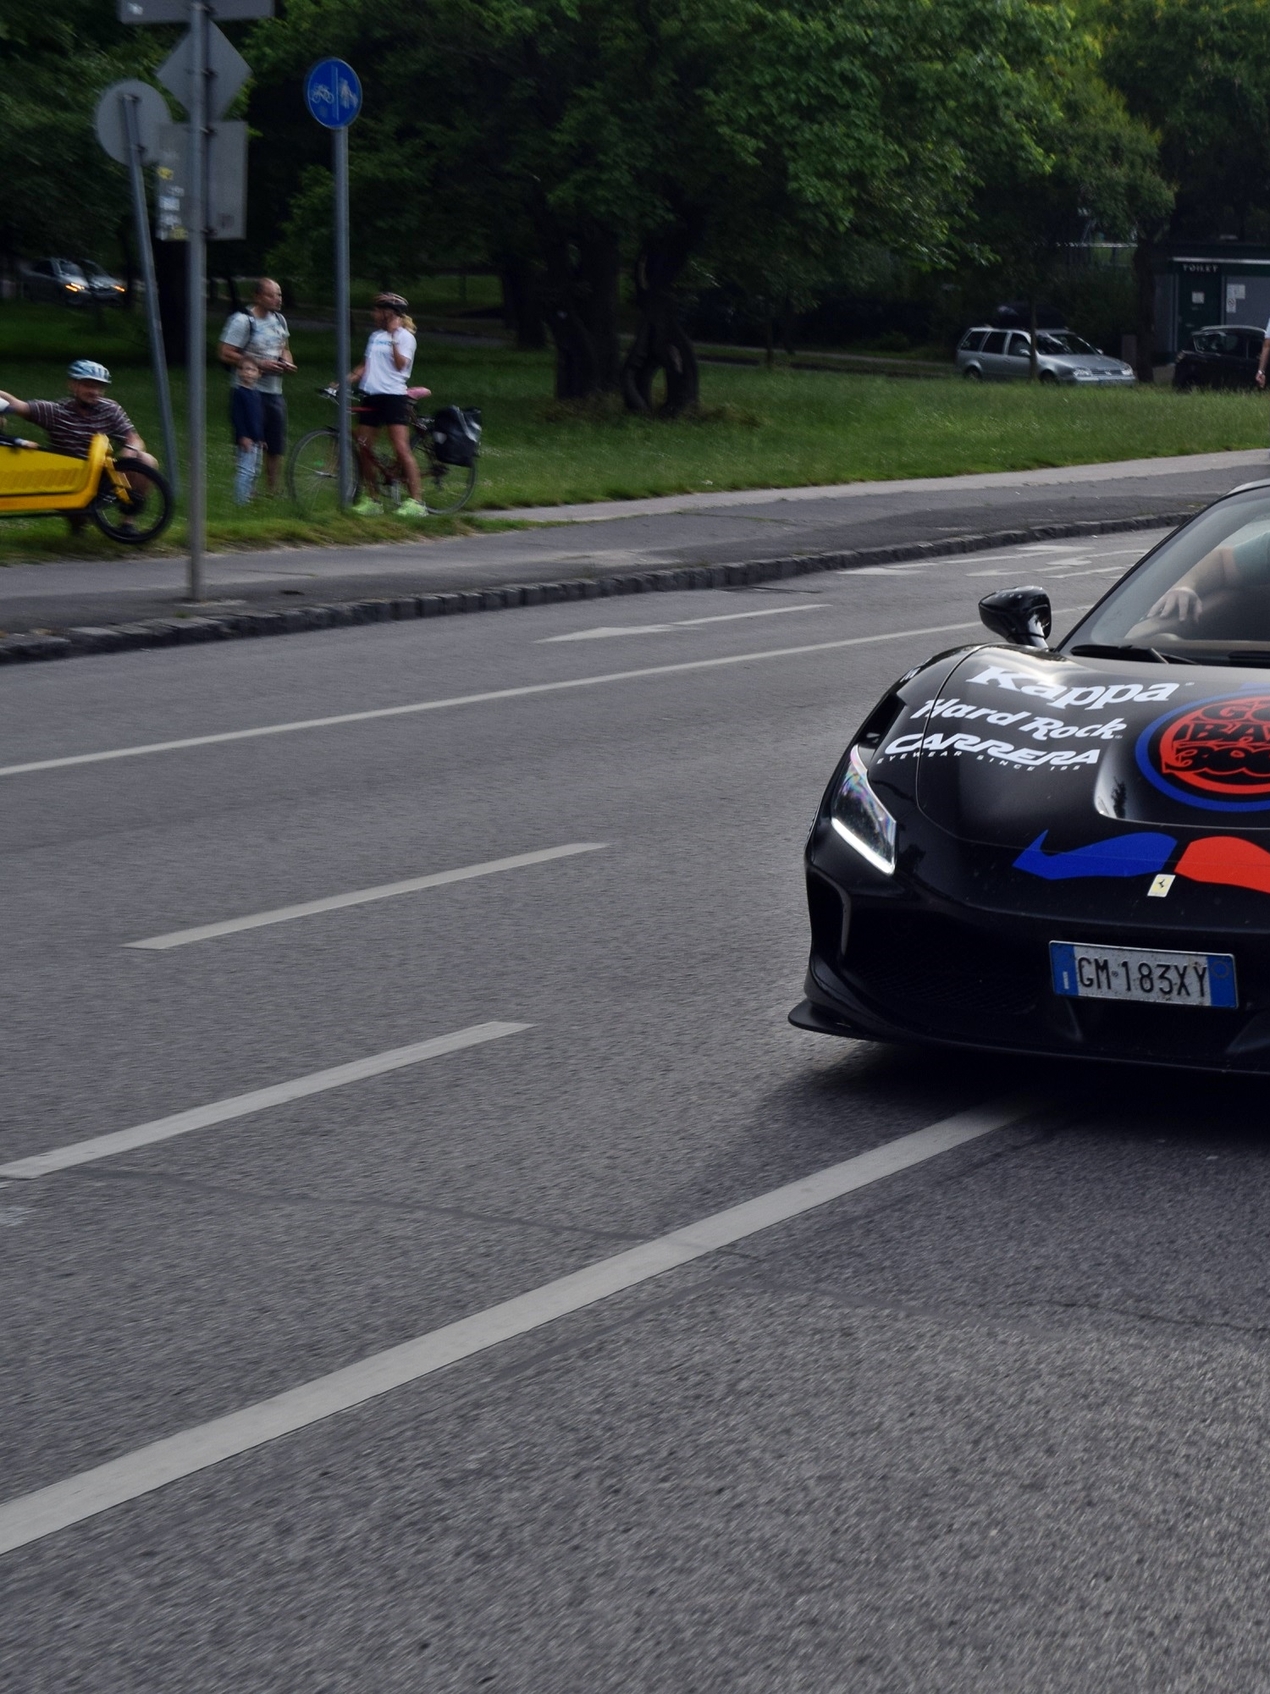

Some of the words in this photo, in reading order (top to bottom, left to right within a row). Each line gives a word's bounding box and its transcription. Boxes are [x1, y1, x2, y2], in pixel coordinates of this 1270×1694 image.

[966, 665, 1180, 710] Kappa
[910, 699, 1031, 727] Hard
[1018, 717, 1127, 741] Rock
[876, 750, 963, 765] EYEWEAR
[976, 754, 1036, 771] SINCE
[885, 732, 1100, 767] CARRERA
